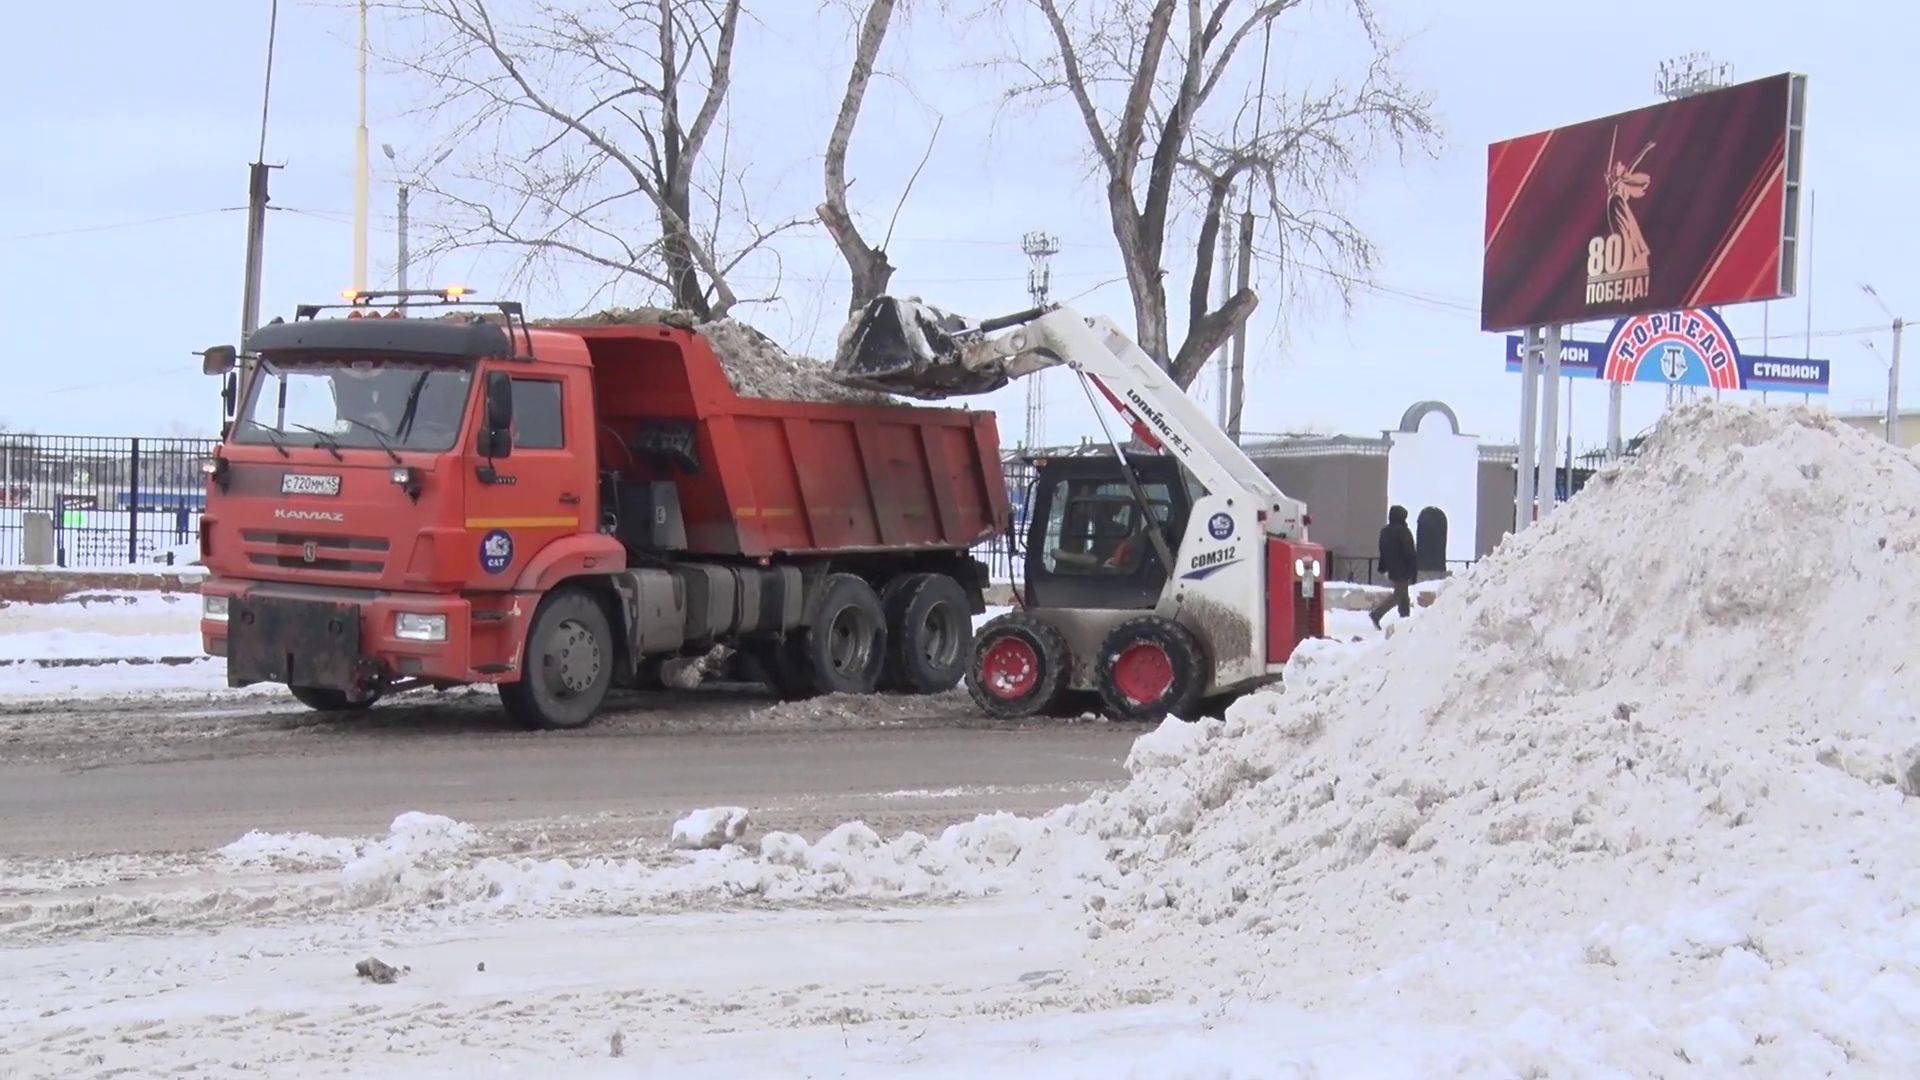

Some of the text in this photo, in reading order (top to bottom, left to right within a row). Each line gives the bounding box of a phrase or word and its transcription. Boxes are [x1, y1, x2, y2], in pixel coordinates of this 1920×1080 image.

[1587, 233, 1623, 277] 80
[1585, 276, 1650, 305] ПОБЕДА!
[1618, 312, 1727, 370] ТОРПЕДО
[1753, 362, 1820, 380] СТАДИОН
[274, 508, 344, 522] KAMAZ
[1190, 546, 1237, 569] CDM312
